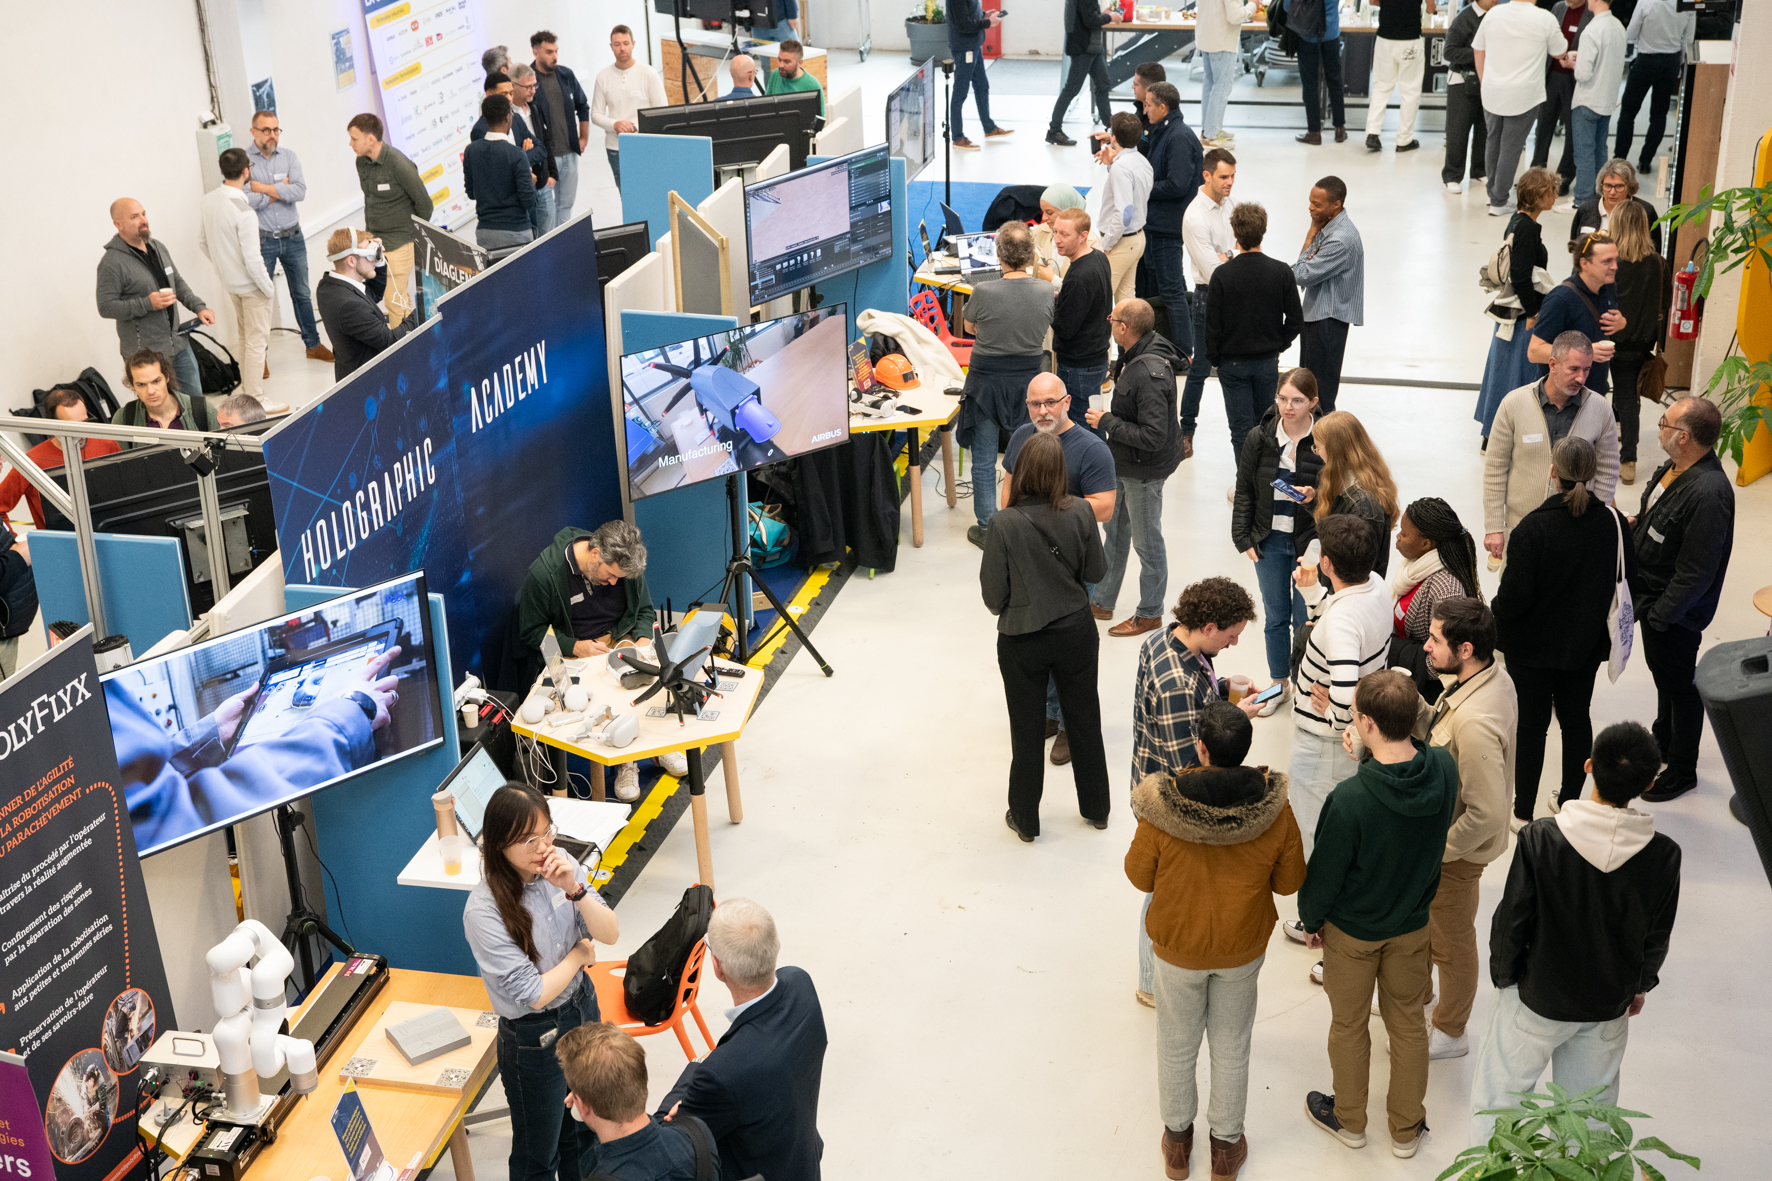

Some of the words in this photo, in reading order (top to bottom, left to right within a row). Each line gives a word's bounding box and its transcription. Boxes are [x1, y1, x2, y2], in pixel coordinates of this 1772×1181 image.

[301, 437, 436, 583] HOLOGRAPHIC
[470, 340, 548, 434] ACADEMY
[658, 440, 733, 468] Manufacturing
[811, 428, 842, 444] AIRBUS
[0, 823, 12, 838] LA
[12, 774, 76, 828] ROBOTISATION
[23, 787, 37, 802] DE
[36, 755, 74, 792] L'AGILITÉ
[6, 787, 82, 852] PARACHÈVEMENT
[21, 872, 32, 884] du
[31, 848, 58, 878] procédé
[58, 840, 70, 856] par
[69, 812, 106, 845] l'opérateur
[0, 891, 24, 915] travers
[24, 885, 32, 895] la
[32, 865, 57, 888] réalité
[56, 838, 92, 870] augmentée
[1, 911, 48, 952] Confinement
[48, 901, 60, 915] des
[60, 881, 82, 906] risques
[4, 950, 18, 967] par
[18, 944, 26, 954] la
[26, 914, 63, 948] séparation
[63, 903, 74, 917] des
[74, 887, 92, 908] zones
[12, 962, 52, 1000] Application
[52, 953, 62, 965] de
[62, 948, 70, 958] la
[70, 913, 109, 951] robotisation
[14, 996, 28, 1011] aux
[28, 975, 52, 1002] petites
[52, 967, 60, 978] et
[60, 940, 93, 973] moyennes
[92, 923, 113, 943] séries
[20, 1005, 64, 1047] Préservation
[64, 996, 74, 1008] de
[74, 964, 108, 1000] l'opérateur
[22, 1047, 31, 1057] et
[31, 1039, 42, 1051] de
[41, 1030, 52, 1043] ses
[52, 992, 94, 1033] savoirs-faire
